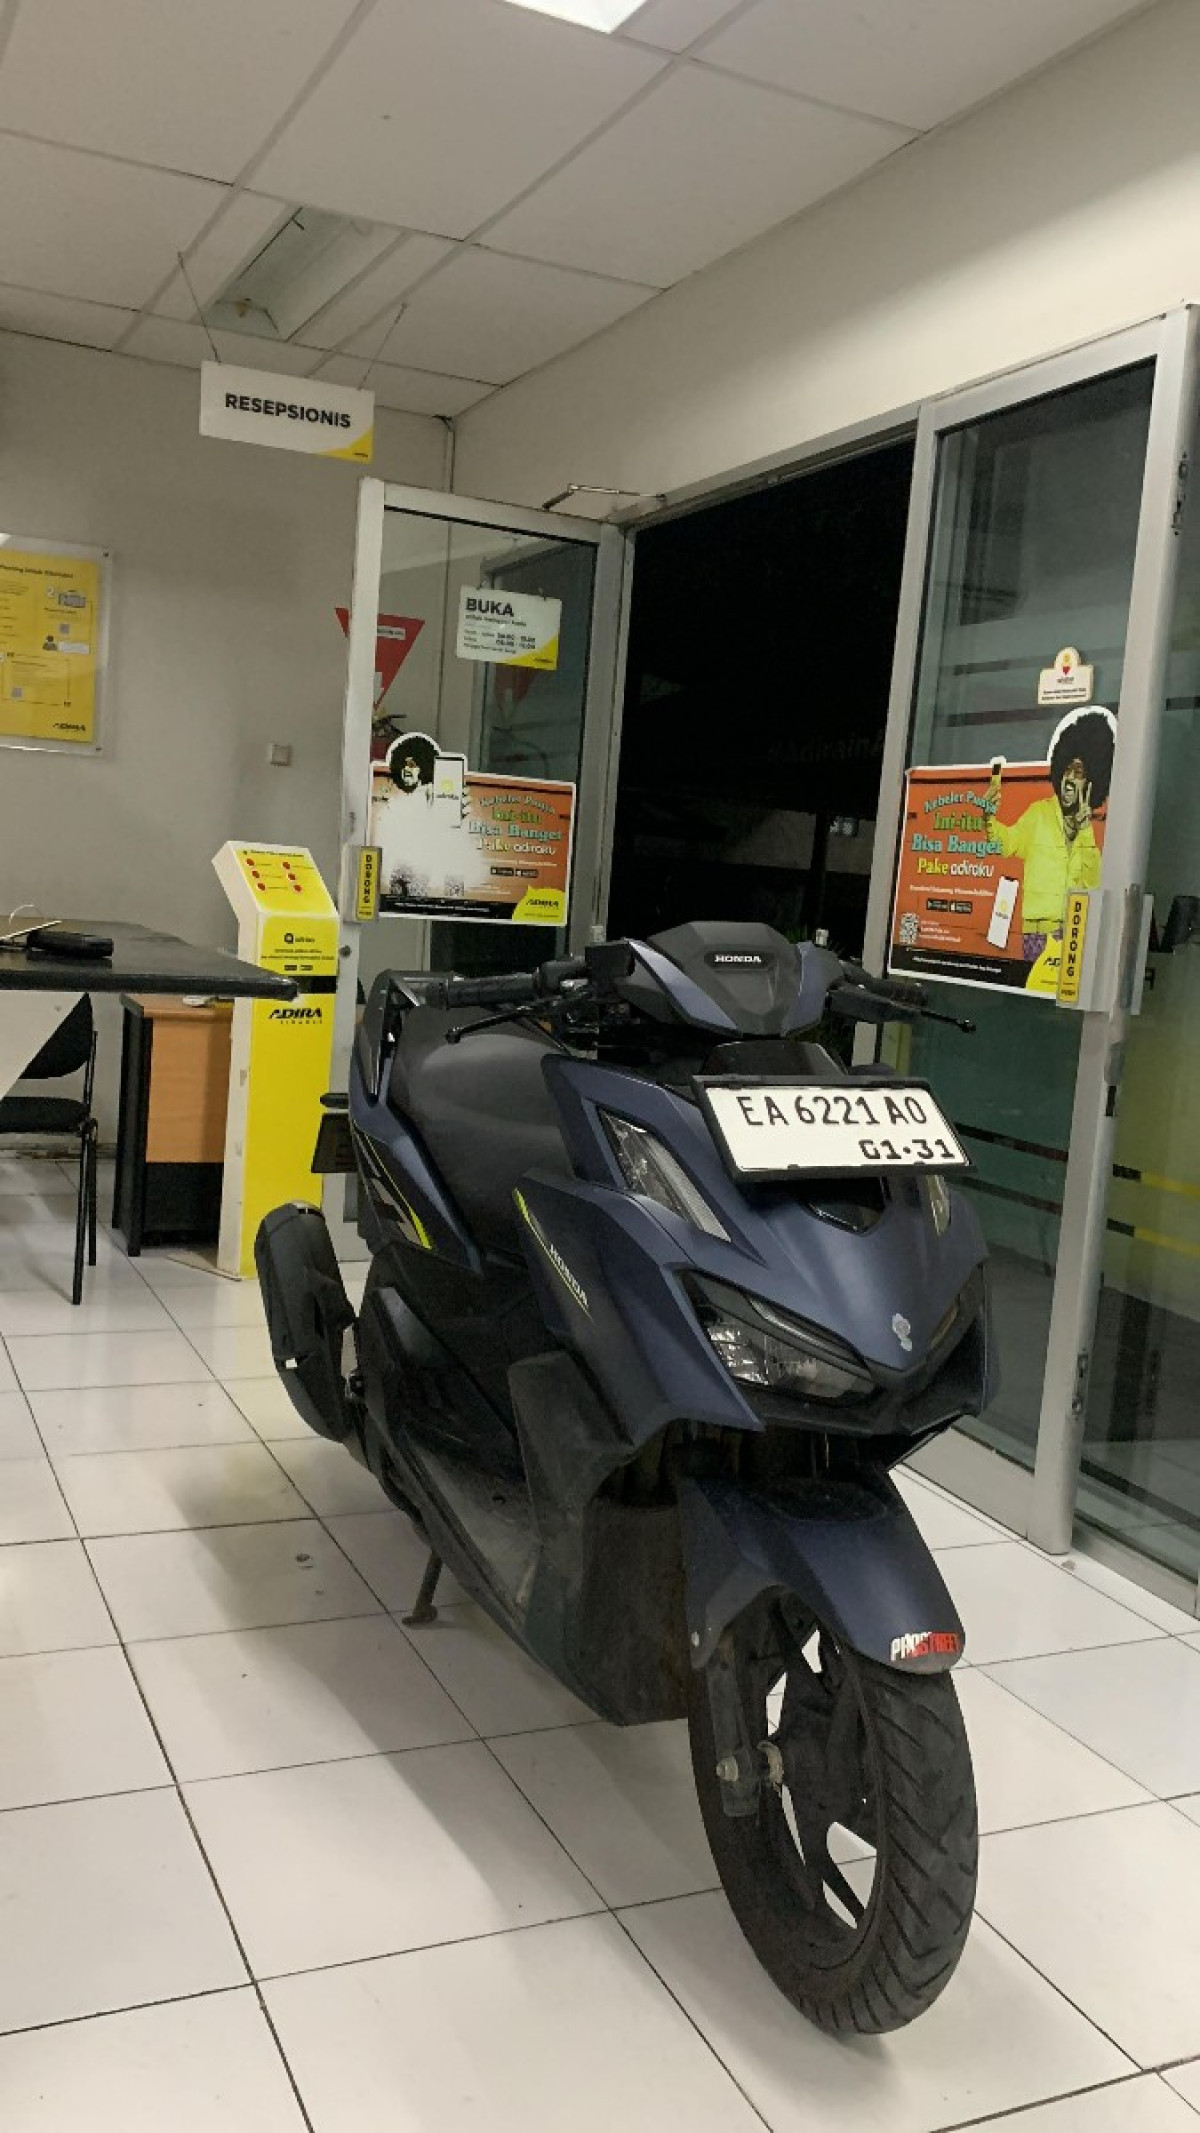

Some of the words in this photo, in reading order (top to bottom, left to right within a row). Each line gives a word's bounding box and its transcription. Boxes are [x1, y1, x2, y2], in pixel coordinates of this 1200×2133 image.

[225, 392, 351, 428] RESEPSIONIS
[465, 597, 514, 617] BUKA
[912, 833, 942, 853] Bisa
[947, 834, 1001, 858] Banget
[917, 857, 948, 875] Pake
[1066, 902, 1082, 977] DORONG
[714, 954, 762, 963] HONDA
[268, 1007, 322, 1019] ADIRA
[736, 1096, 789, 1126] EA
[795, 1095, 880, 1125] 6221
[550, 1243, 589, 1309] HONDA
